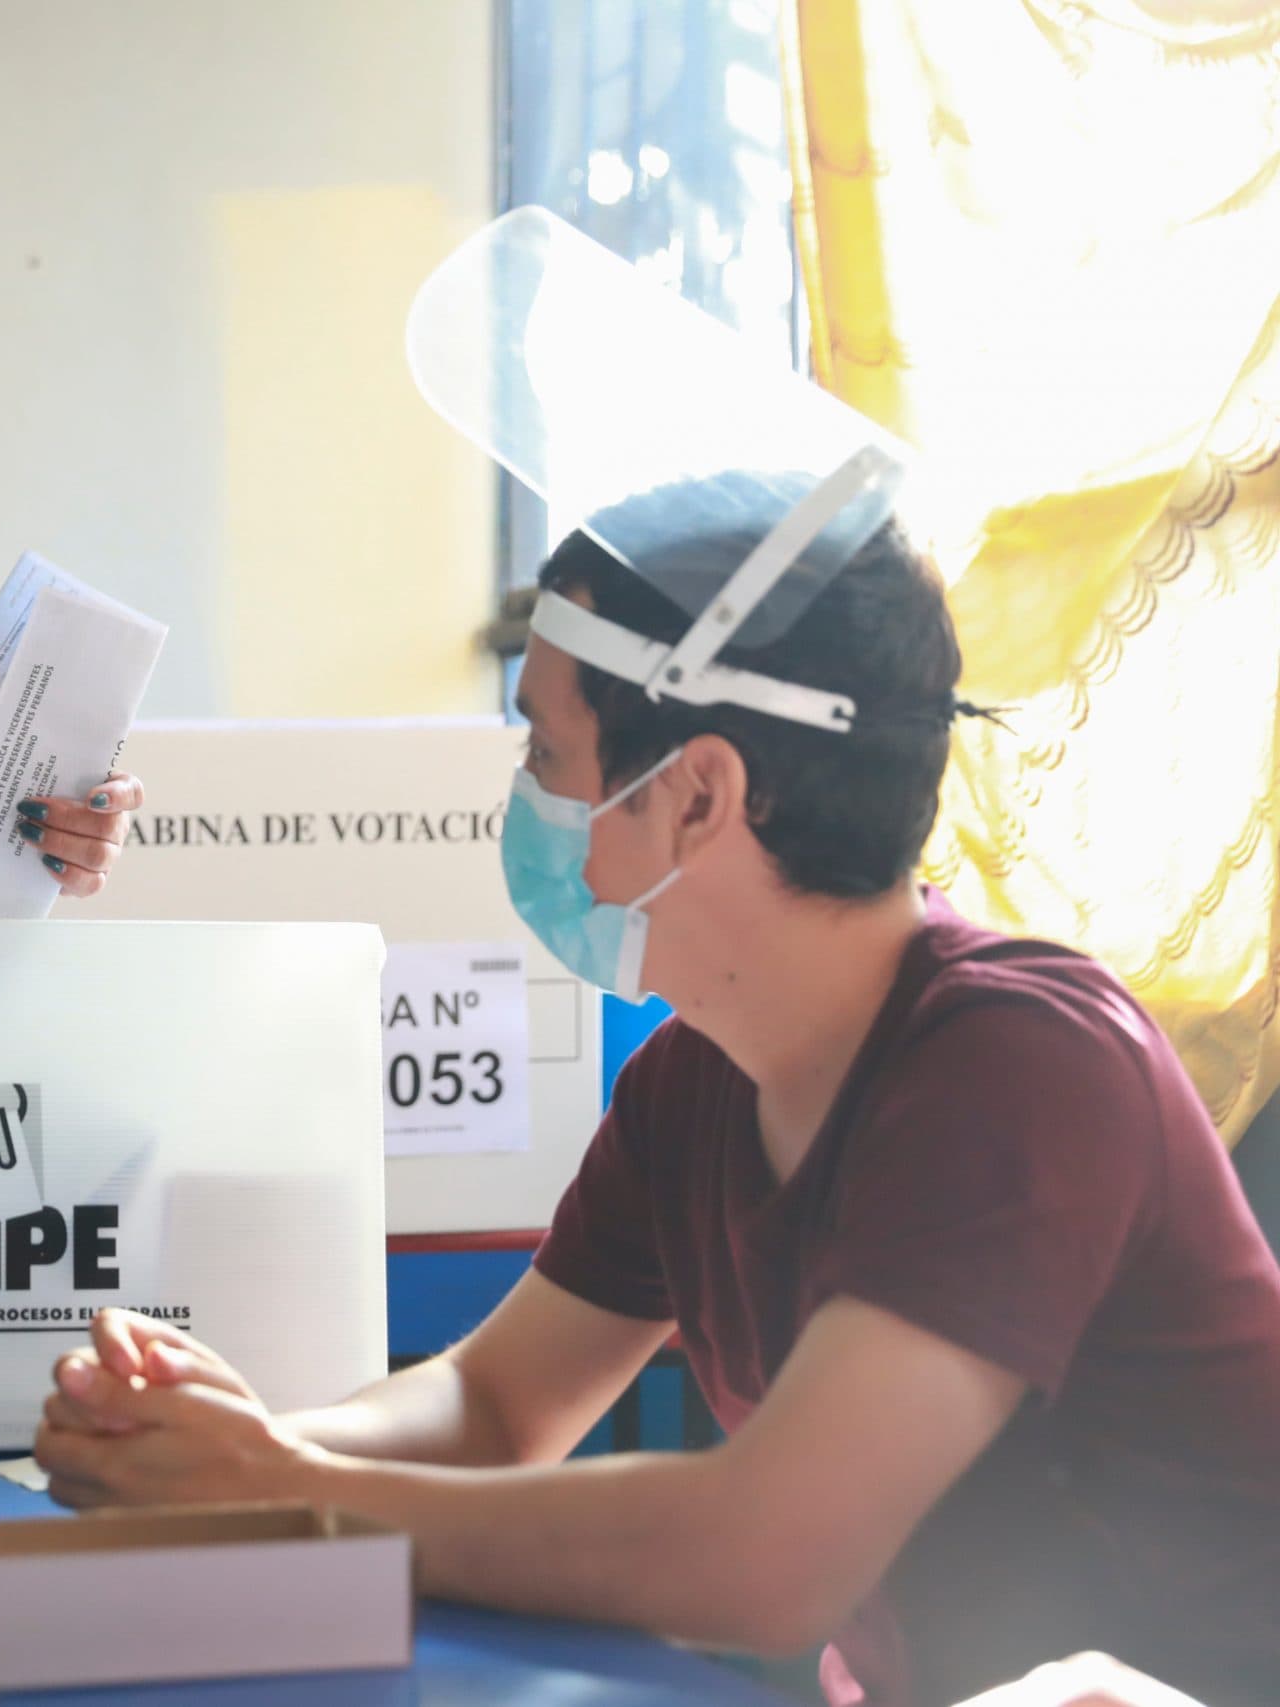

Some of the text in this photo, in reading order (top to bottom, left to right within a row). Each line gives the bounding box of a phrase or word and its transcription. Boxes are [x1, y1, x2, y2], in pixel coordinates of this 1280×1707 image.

[0, 709, 35, 783] REPRESENTANTES
[29, 664, 54, 710] PERUANOS
[18, 733, 38, 768] ANDINO
[31, 760, 44, 782] 2026
[35, 753, 58, 798] ECTORALES
[124, 802, 503, 845] ABINA DE VOTACIÓ
[388, 1051, 503, 1108] 053
